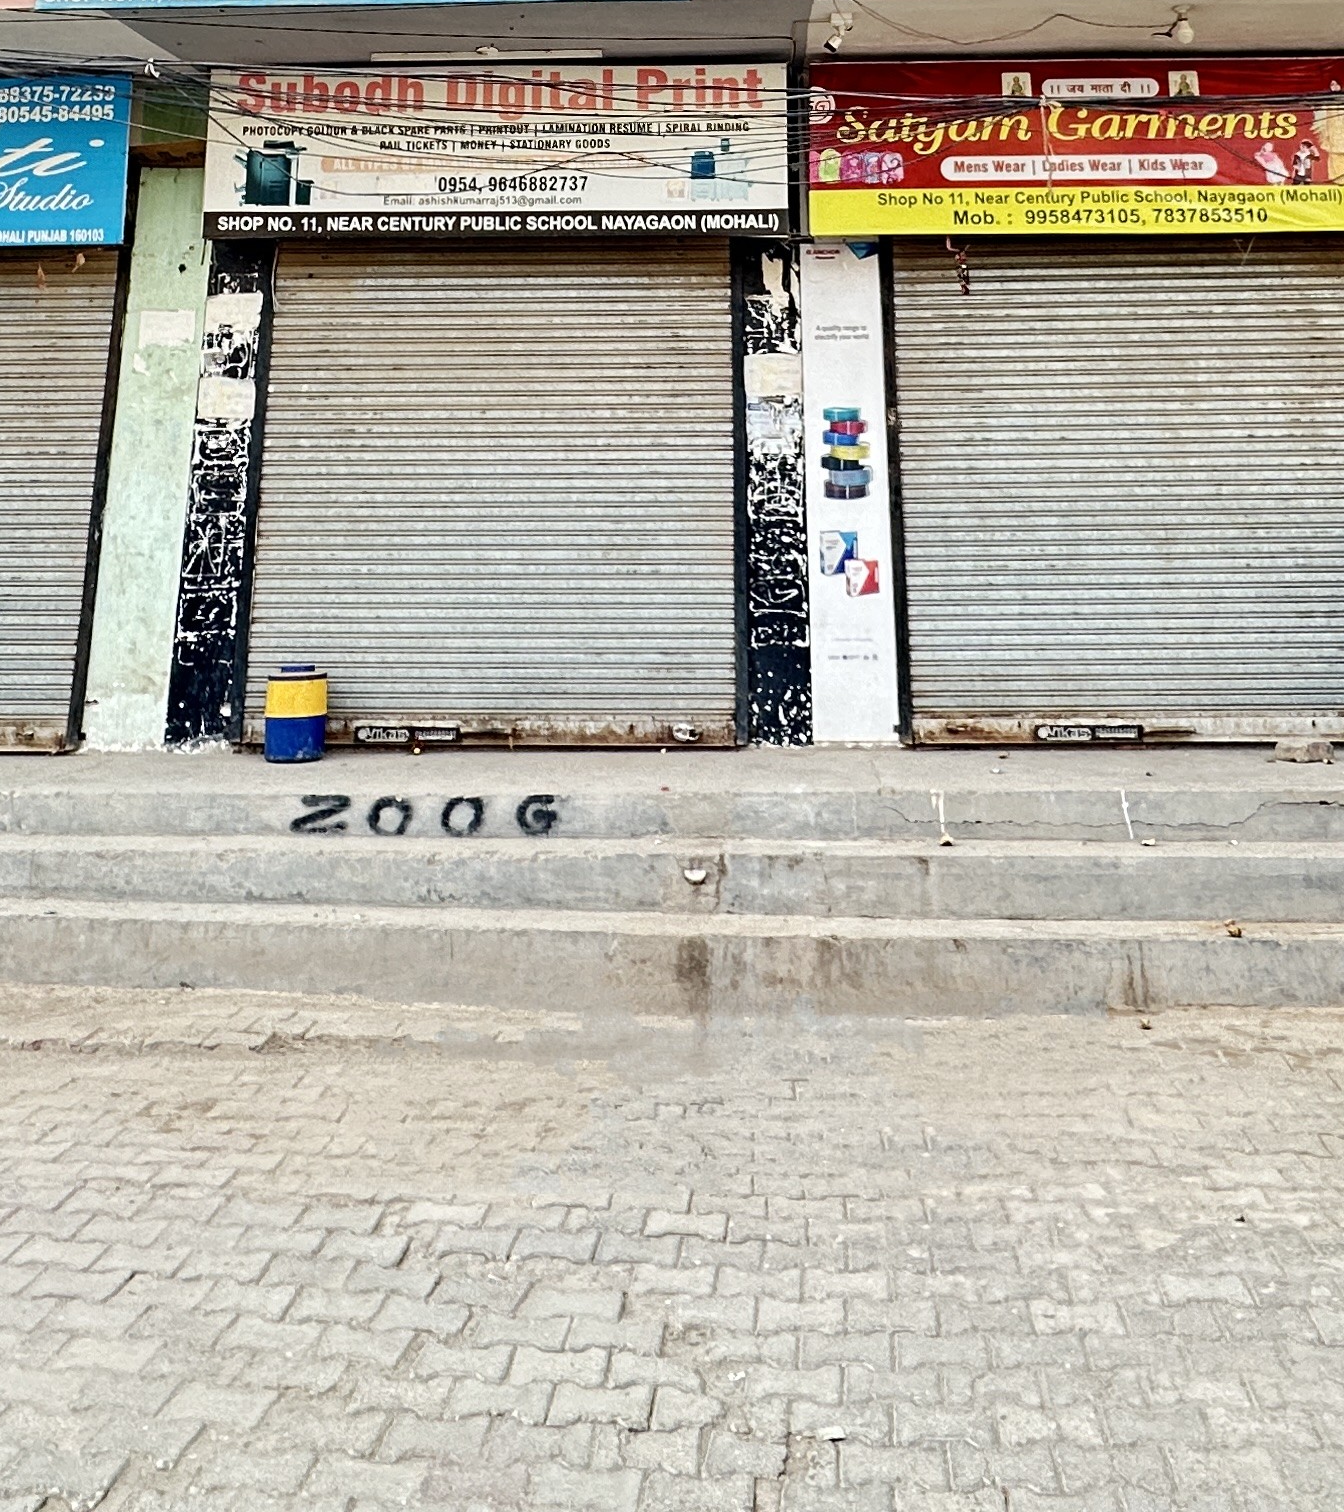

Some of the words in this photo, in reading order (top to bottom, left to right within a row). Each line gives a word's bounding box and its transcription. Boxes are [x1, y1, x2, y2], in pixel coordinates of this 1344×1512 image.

[237, 71, 424, 116] Subodh
[446, 68, 614, 122] Digital
[636, 68, 763, 112] Print
[1067, 83, 1084, 94] जय
[1090, 83, 1115, 94] माता
[1119, 80, 1132, 94] दी
[242, 126, 305, 137] PHOTOCOPY
[398, 125, 431, 136] SPARE
[541, 123, 607, 135] LAMINATION
[609, 122, 653, 134] RESUME
[665, 122, 703, 133] SPIRAL
[706, 121, 750, 132] BINDING
[836, 106, 1032, 155] Satyam
[1047, 100, 1298, 140] Garments
[406, 139, 448, 151] TICKETS
[509, 139, 572, 150] STATIONARY
[575, 138, 611, 150] GOODS
[953, 160, 988, 173] Mens
[992, 159, 1026, 173] Wear
[1042, 158, 1084, 172] Ladies
[1088, 158, 1122, 172] Wear
[1138, 157, 1166, 171] Kids
[1169, 158, 1204, 171] Wear
[488, 175, 589, 192] 9646882737
[383, 195, 416, 206] Email:
[418, 195, 582, 209] ashishkumarraj513@gmail.com
[877, 192, 918, 209] Shop
[922, 192, 944, 206] No
[948, 192, 970, 207] 11,
[974, 191, 1010, 205] Near
[1014, 190, 1075, 207] Century
[1080, 190, 1129, 204] Public
[1133, 189, 1193, 205] School,
[1197, 189, 1276, 206] Nayagaon
[1280, 188, 1343, 206] (Mohali)
[217, 216, 264, 231] SHOP
[267, 216, 296, 231] NO.
[301, 216, 323, 234] 11,
[326, 216, 374, 231] NEAR
[377, 216, 456, 231] CENTURY
[460, 216, 522, 231] PUBLIC
[525, 215, 598, 231] SCHOOL
[601, 215, 697, 230] NAYAGAON
[700, 214, 780, 231] (MOHALI)
[953, 210, 1001, 225] Mob.
[1025, 208, 1147, 226] 9958473105,
[1152, 206, 1268, 224] 7837853510
[27, 229, 67, 242] PUNJAB
[70, 228, 104, 242] 160103
